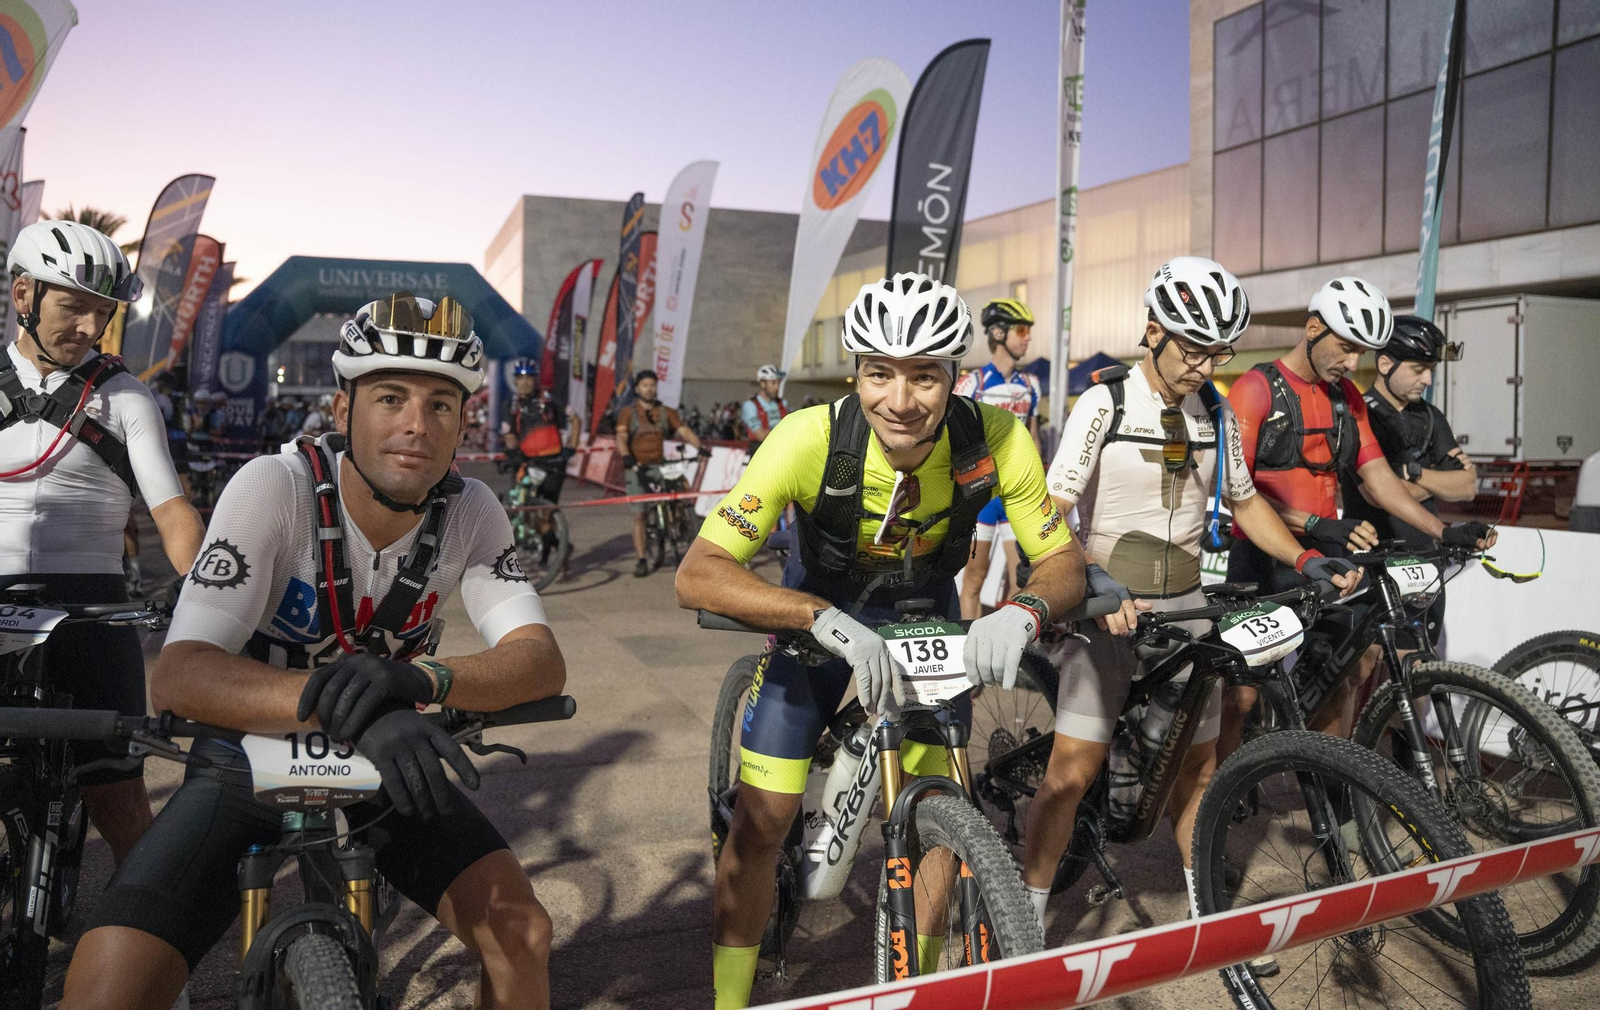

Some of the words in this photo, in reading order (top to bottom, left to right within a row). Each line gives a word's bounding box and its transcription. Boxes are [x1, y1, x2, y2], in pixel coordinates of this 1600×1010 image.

[318, 268, 449, 289] UNIVERSAE
[202, 554, 231, 577] FB
[1402, 567, 1425, 580] 137
[0, 619, 20, 627] RDI
[1242, 616, 1280, 638] 133
[1256, 629, 1286, 647] VICENTE
[901, 639, 949, 663] 138
[914, 665, 944, 674] JAVIER
[289, 765, 351, 776] ANTONIO
[827, 737, 877, 867] ORBEA
[891, 930, 909, 982] FOX
